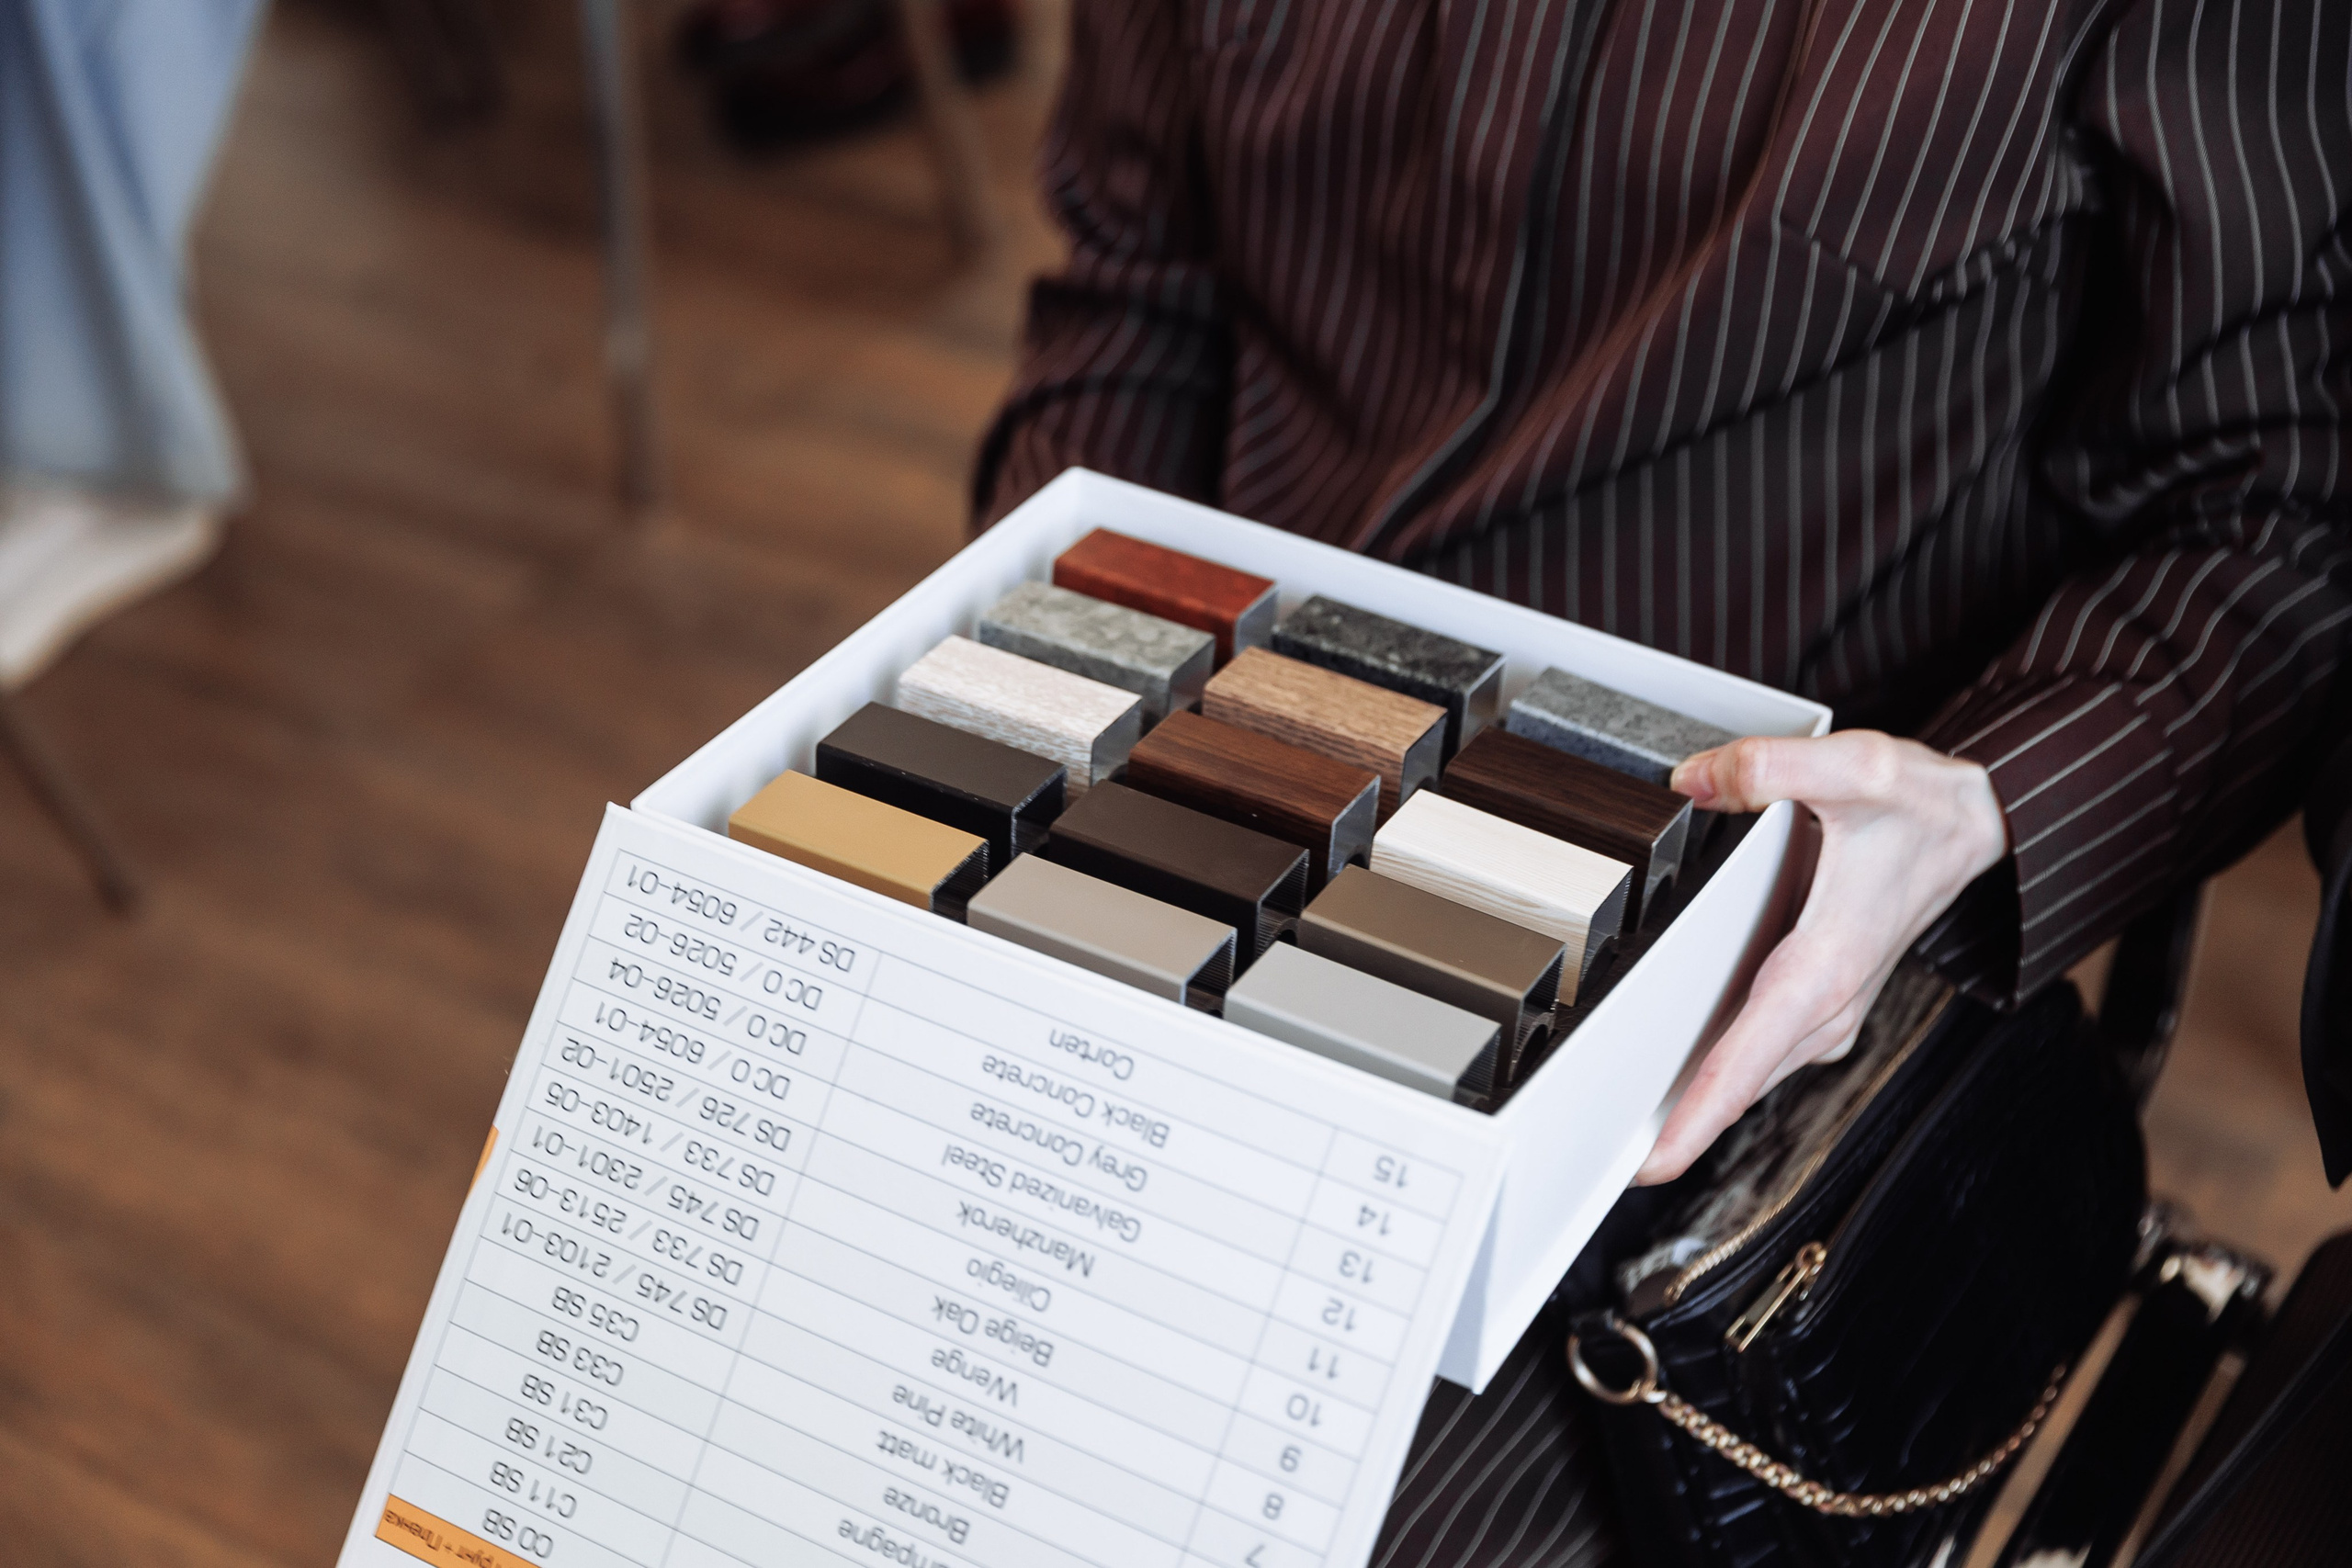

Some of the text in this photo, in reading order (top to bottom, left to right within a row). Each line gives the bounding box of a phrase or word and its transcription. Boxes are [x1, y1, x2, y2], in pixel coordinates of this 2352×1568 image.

[624, 913, 738, 977] 5026-02
[628, 865, 856, 974] DS 442 / 6054-01
[609, 957, 722, 1021] 5026-04
[740, 961, 763, 982] /
[785, 978, 824, 1011] DC
[595, 1002, 707, 1065] 6054-01
[725, 1005, 747, 1026] /
[769, 1023, 808, 1056] DC
[708, 1050, 732, 1071] /
[1048, 1027, 1135, 1081] Corten
[561, 1037, 792, 1153] DS 726 / 2501-02
[753, 1067, 792, 1101] DC
[981, 1054, 1170, 1149] Black Concrete
[545, 1082, 776, 1198] DS 733 / 1403-05
[970, 1102, 1148, 1192] Grey Concrete
[533, 1126, 761, 1242] DS 745 / 2301-01
[942, 1145, 1141, 1244] Galvanized Steel
[1374, 1156, 1408, 1190] 15
[514, 1168, 744, 1287] DS 733 / 2513-06
[957, 1200, 1095, 1279] Manzherok
[1357, 1204, 1391, 1237] 14
[502, 1213, 729, 1332] DS 745 / 2103-01
[967, 1256, 1052, 1314] Ciliegio
[1339, 1250, 1374, 1285] 13
[551, 1286, 640, 1343] C35 SB
[931, 1294, 1055, 1369] Beige Oak
[1320, 1298, 1356, 1334] 12
[536, 1330, 625, 1387] C33 SB
[931, 1347, 1018, 1407] Wenge
[1307, 1345, 1340, 1381] 11
[521, 1373, 609, 1431] C31 SB
[892, 1384, 1025, 1465] White Pine
[1285, 1393, 1322, 1428] 10
[505, 1417, 594, 1475] C21 SB
[876, 1429, 1011, 1510] Black matt
[1279, 1446, 1302, 1472] 9
[490, 1461, 578, 1519] C11 SB
[883, 1485, 970, 1546] Bronze
[1261, 1493, 1284, 1521] 8
[482, 1508, 517, 1540] SB
[1244, 1542, 1266, 1568] 7
